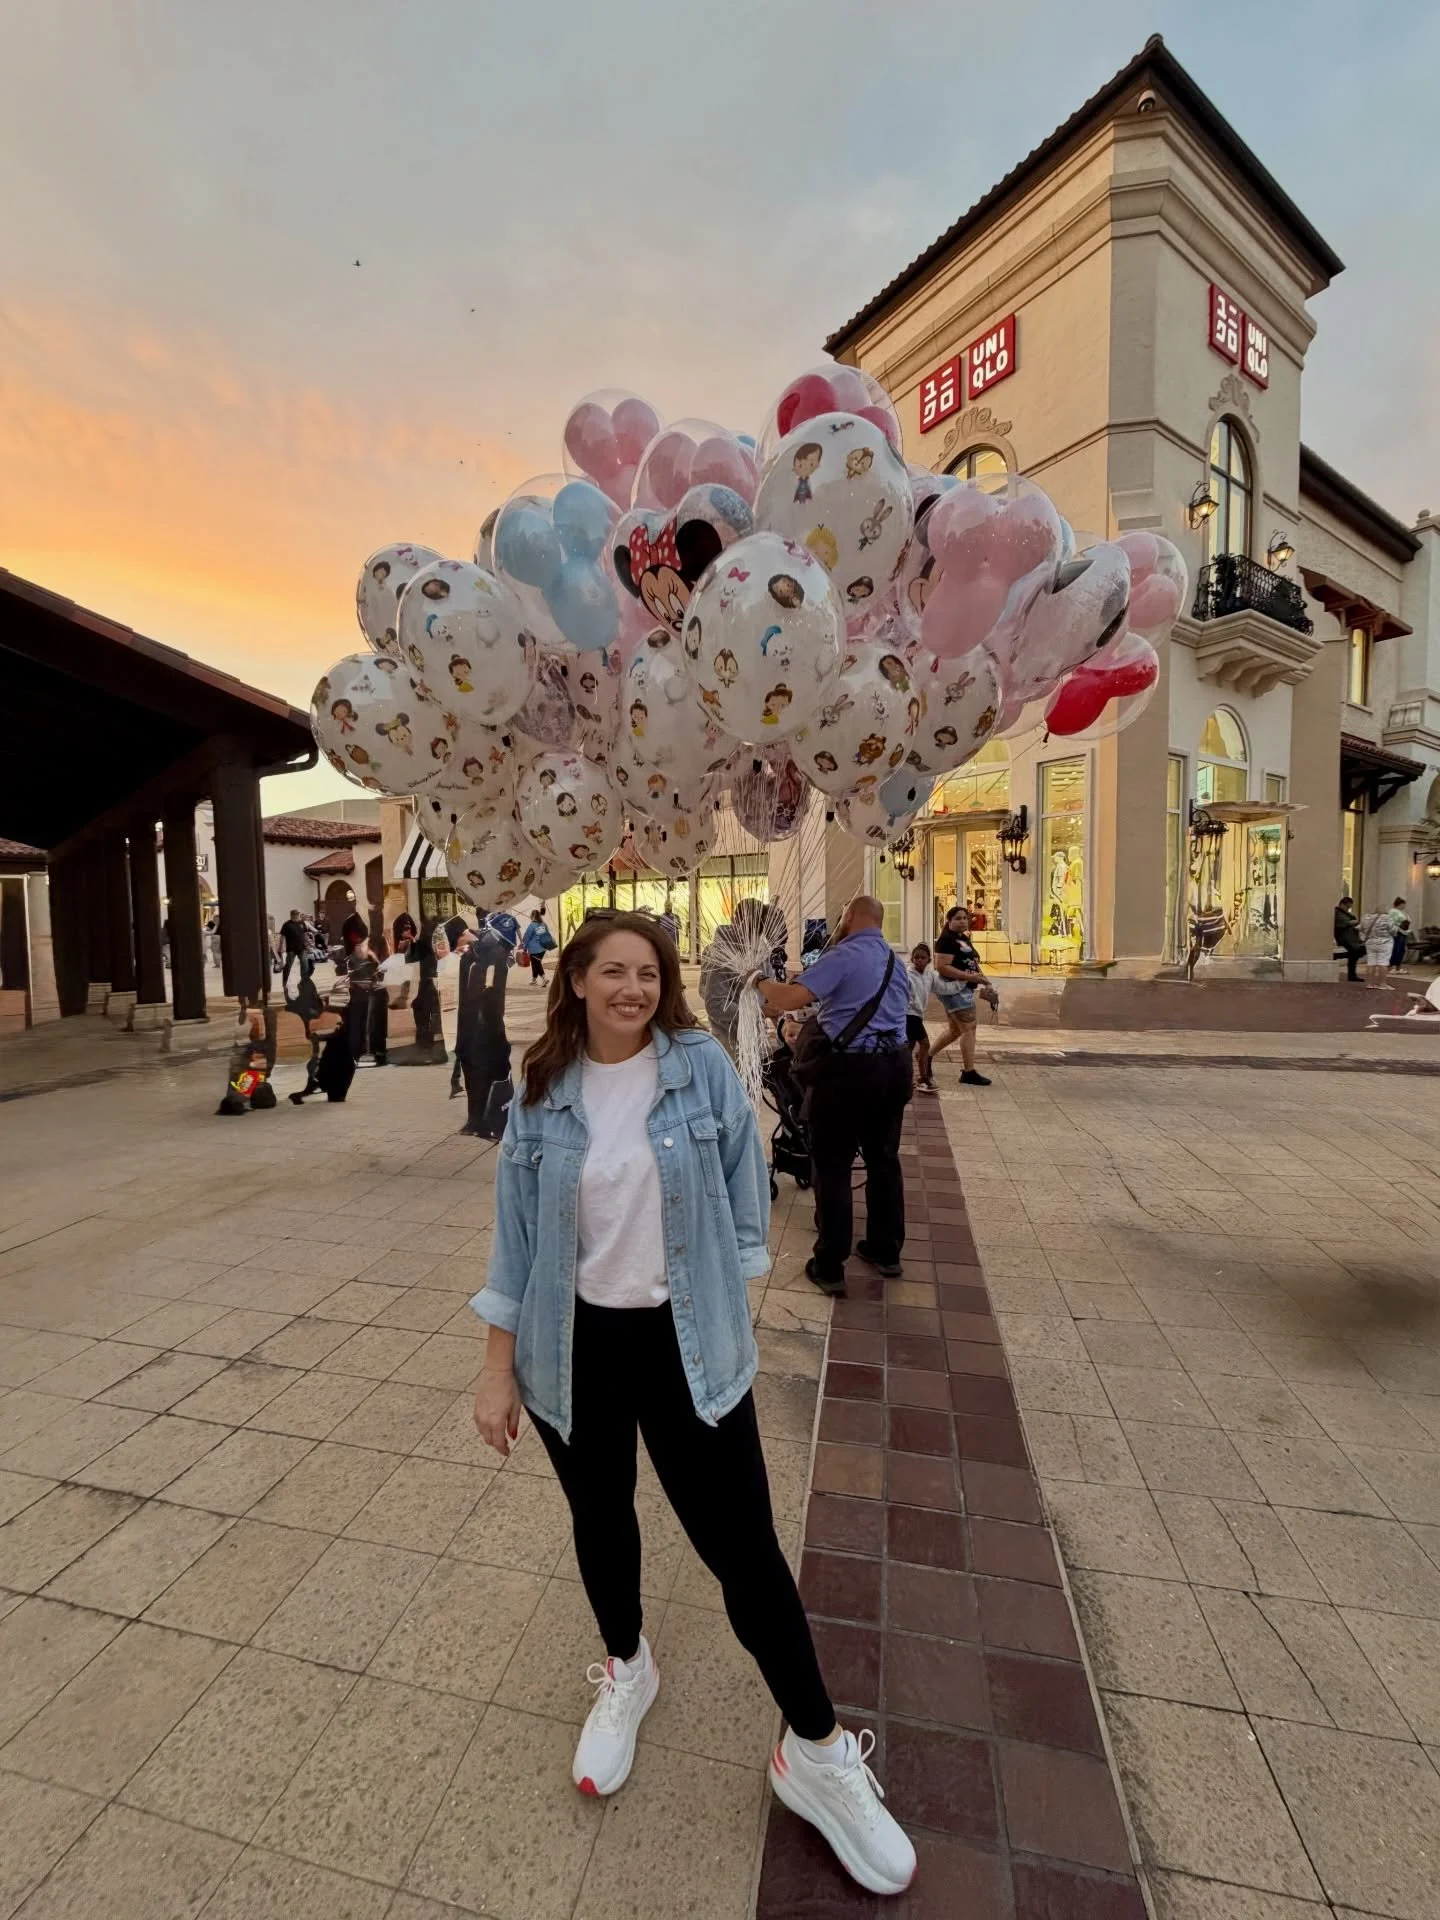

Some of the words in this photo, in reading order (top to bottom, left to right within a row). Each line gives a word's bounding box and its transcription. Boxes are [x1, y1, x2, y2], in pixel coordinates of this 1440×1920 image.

[973, 327, 1005, 366] UNI
[1248, 323, 1267, 355] UNI
[973, 350, 1008, 389] QLO
[1247, 347, 1268, 377] QLO
